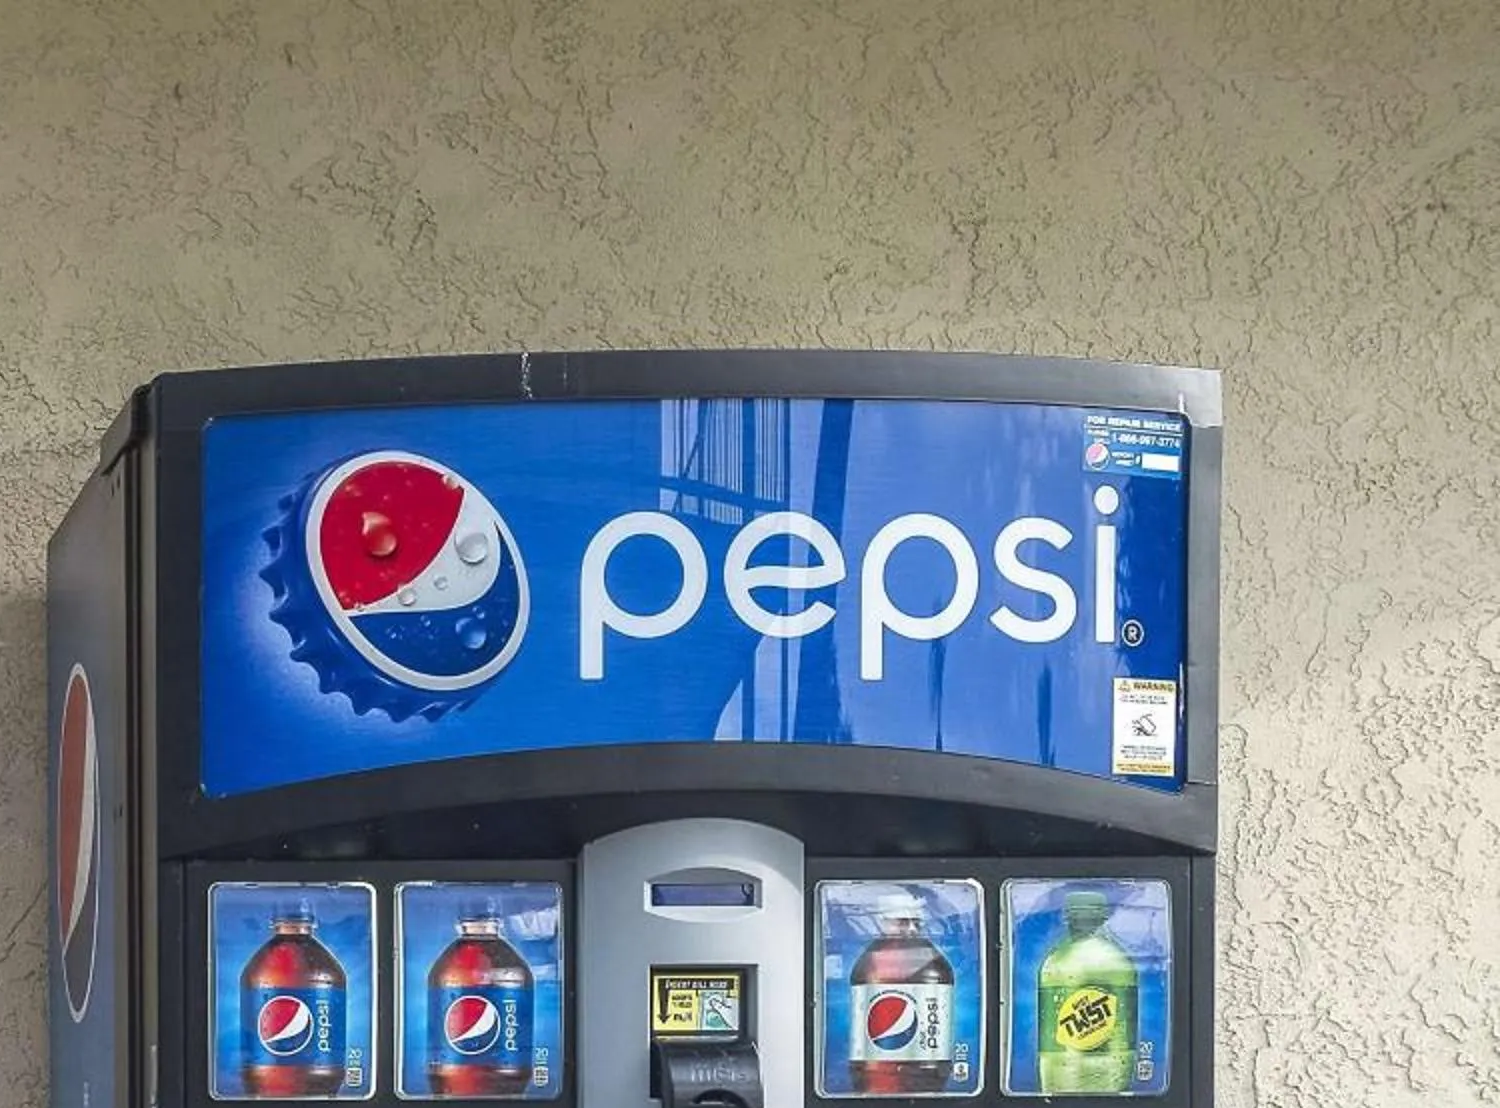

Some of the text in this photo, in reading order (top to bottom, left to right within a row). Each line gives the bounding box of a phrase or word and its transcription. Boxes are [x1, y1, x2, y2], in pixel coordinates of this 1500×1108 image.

[1087, 415, 1181, 431] FOR REPAIR SERVICE
[579, 484, 1120, 681] pepsi
[1133, 681, 1175, 693] WARNING
[316, 999, 333, 1053] pepsi
[502, 999, 520, 1052] pepsi
[925, 997, 940, 1049] pepsi
